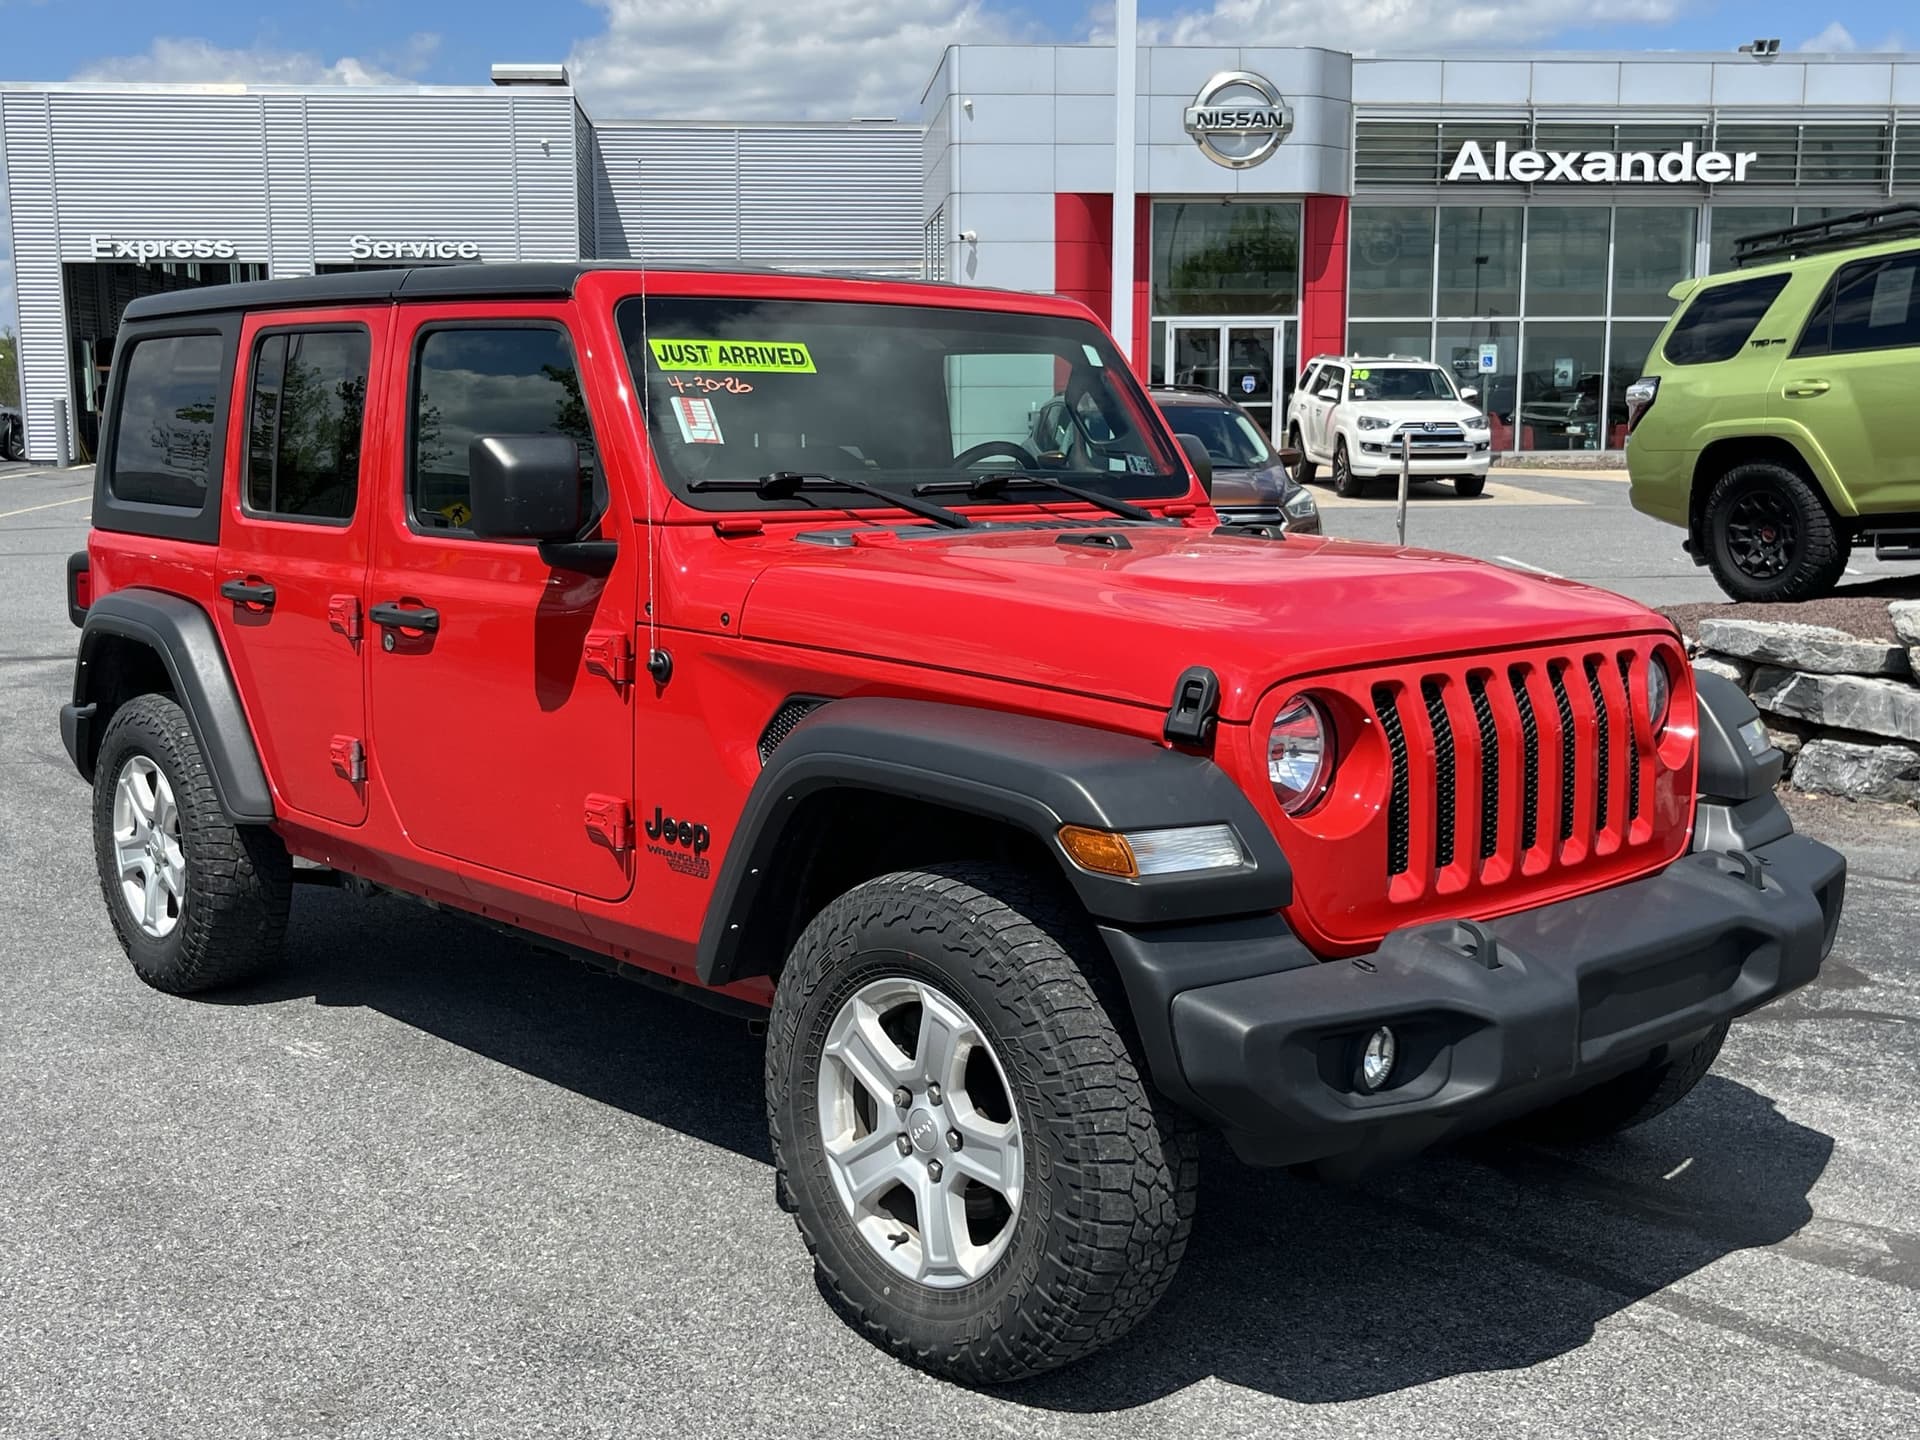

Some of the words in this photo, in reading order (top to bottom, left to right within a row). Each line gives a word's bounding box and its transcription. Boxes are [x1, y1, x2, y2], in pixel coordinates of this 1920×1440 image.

[1196, 111, 1283, 128] NISSAN
[1447, 141, 1756, 183] Alexander
[90, 234, 235, 263] Express
[350, 235, 479, 259] Service
[658, 344, 710, 364] JUST
[719, 346, 808, 366] ARRIVED
[667, 376, 753, 393] 4-30-26
[1351, 369, 1370, 380] 20
[645, 806, 711, 858] Jeep
